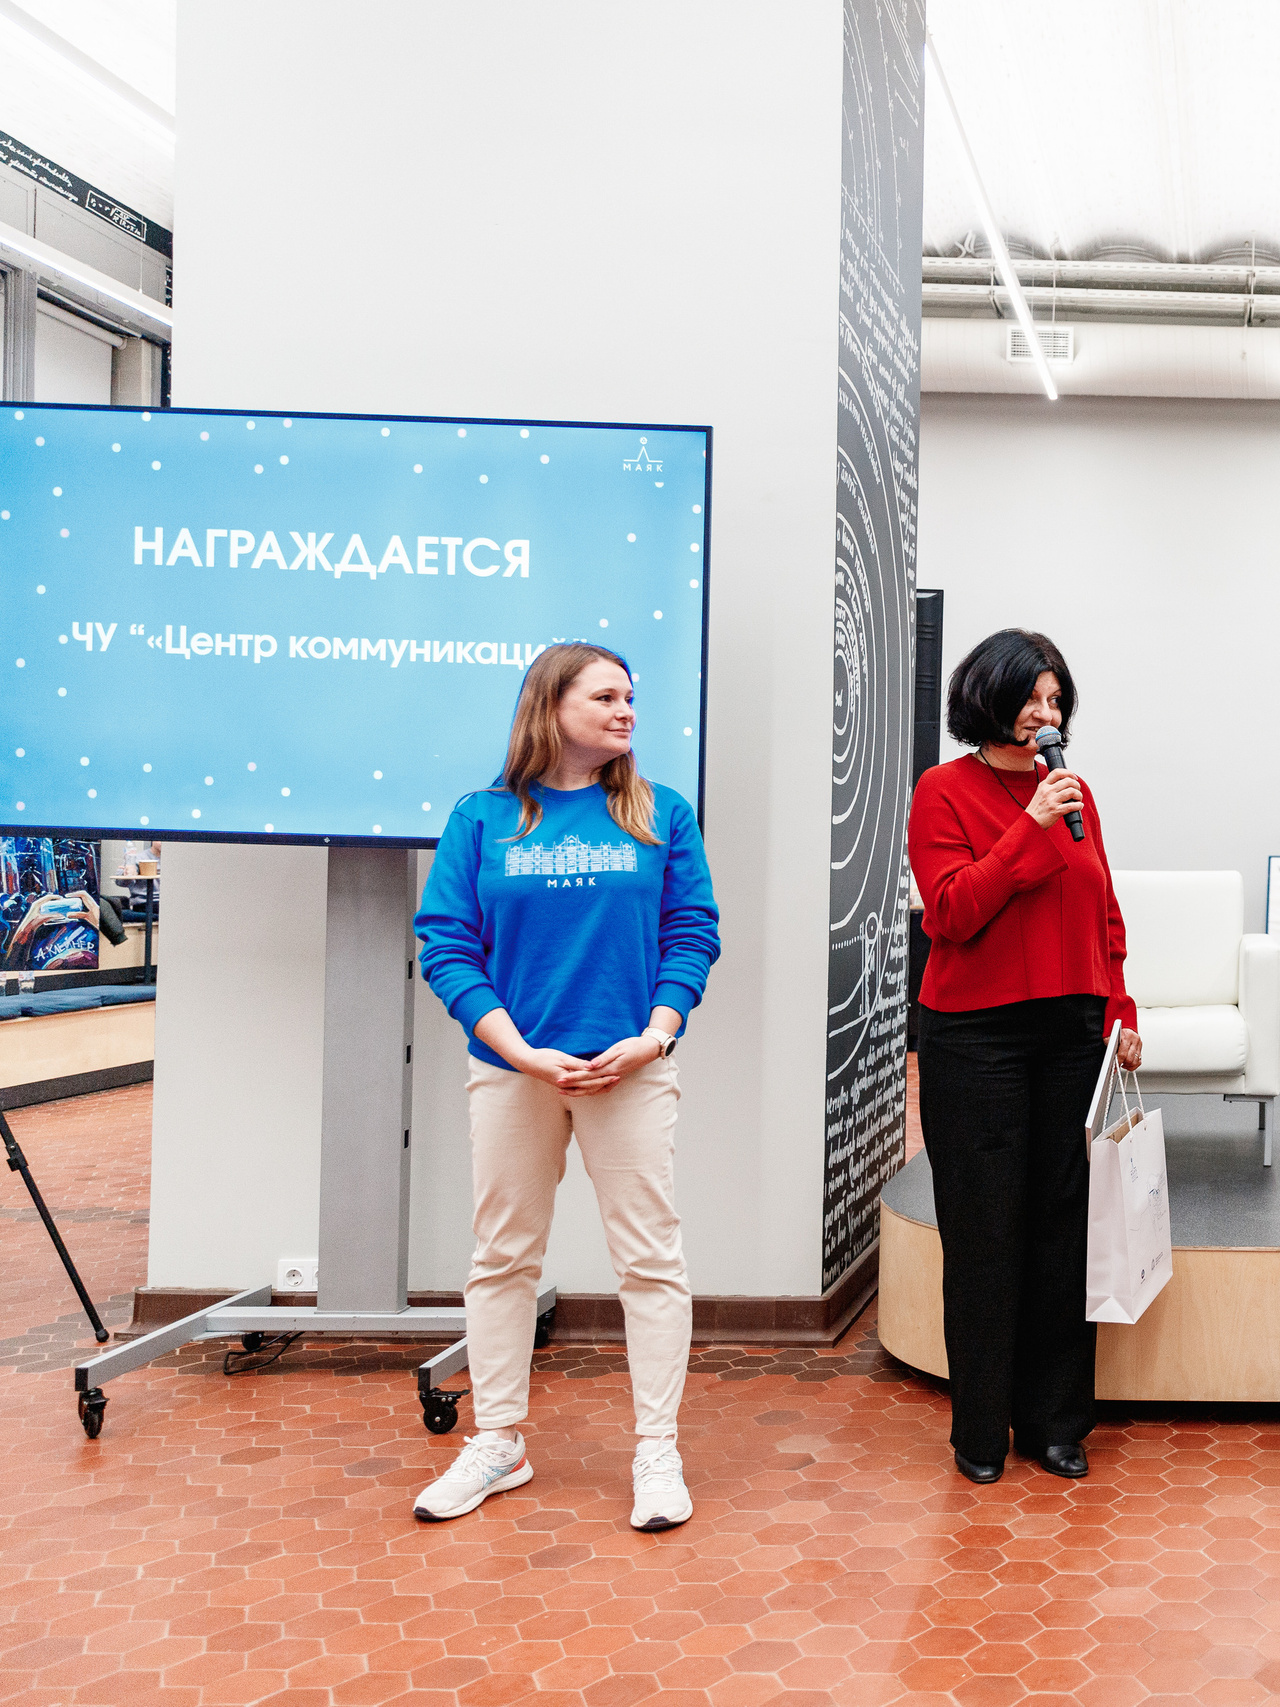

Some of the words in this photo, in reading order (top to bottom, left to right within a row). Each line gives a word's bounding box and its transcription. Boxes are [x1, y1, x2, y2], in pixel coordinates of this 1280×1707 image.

[623, 463, 663, 472] МАЯК
[133, 526, 531, 579] НАГРАЖДАЕТСЯ
[71, 621, 118, 652] ЧУ
[288, 636, 567, 671] коммуникаци
[547, 877, 597, 888] МАЯК
